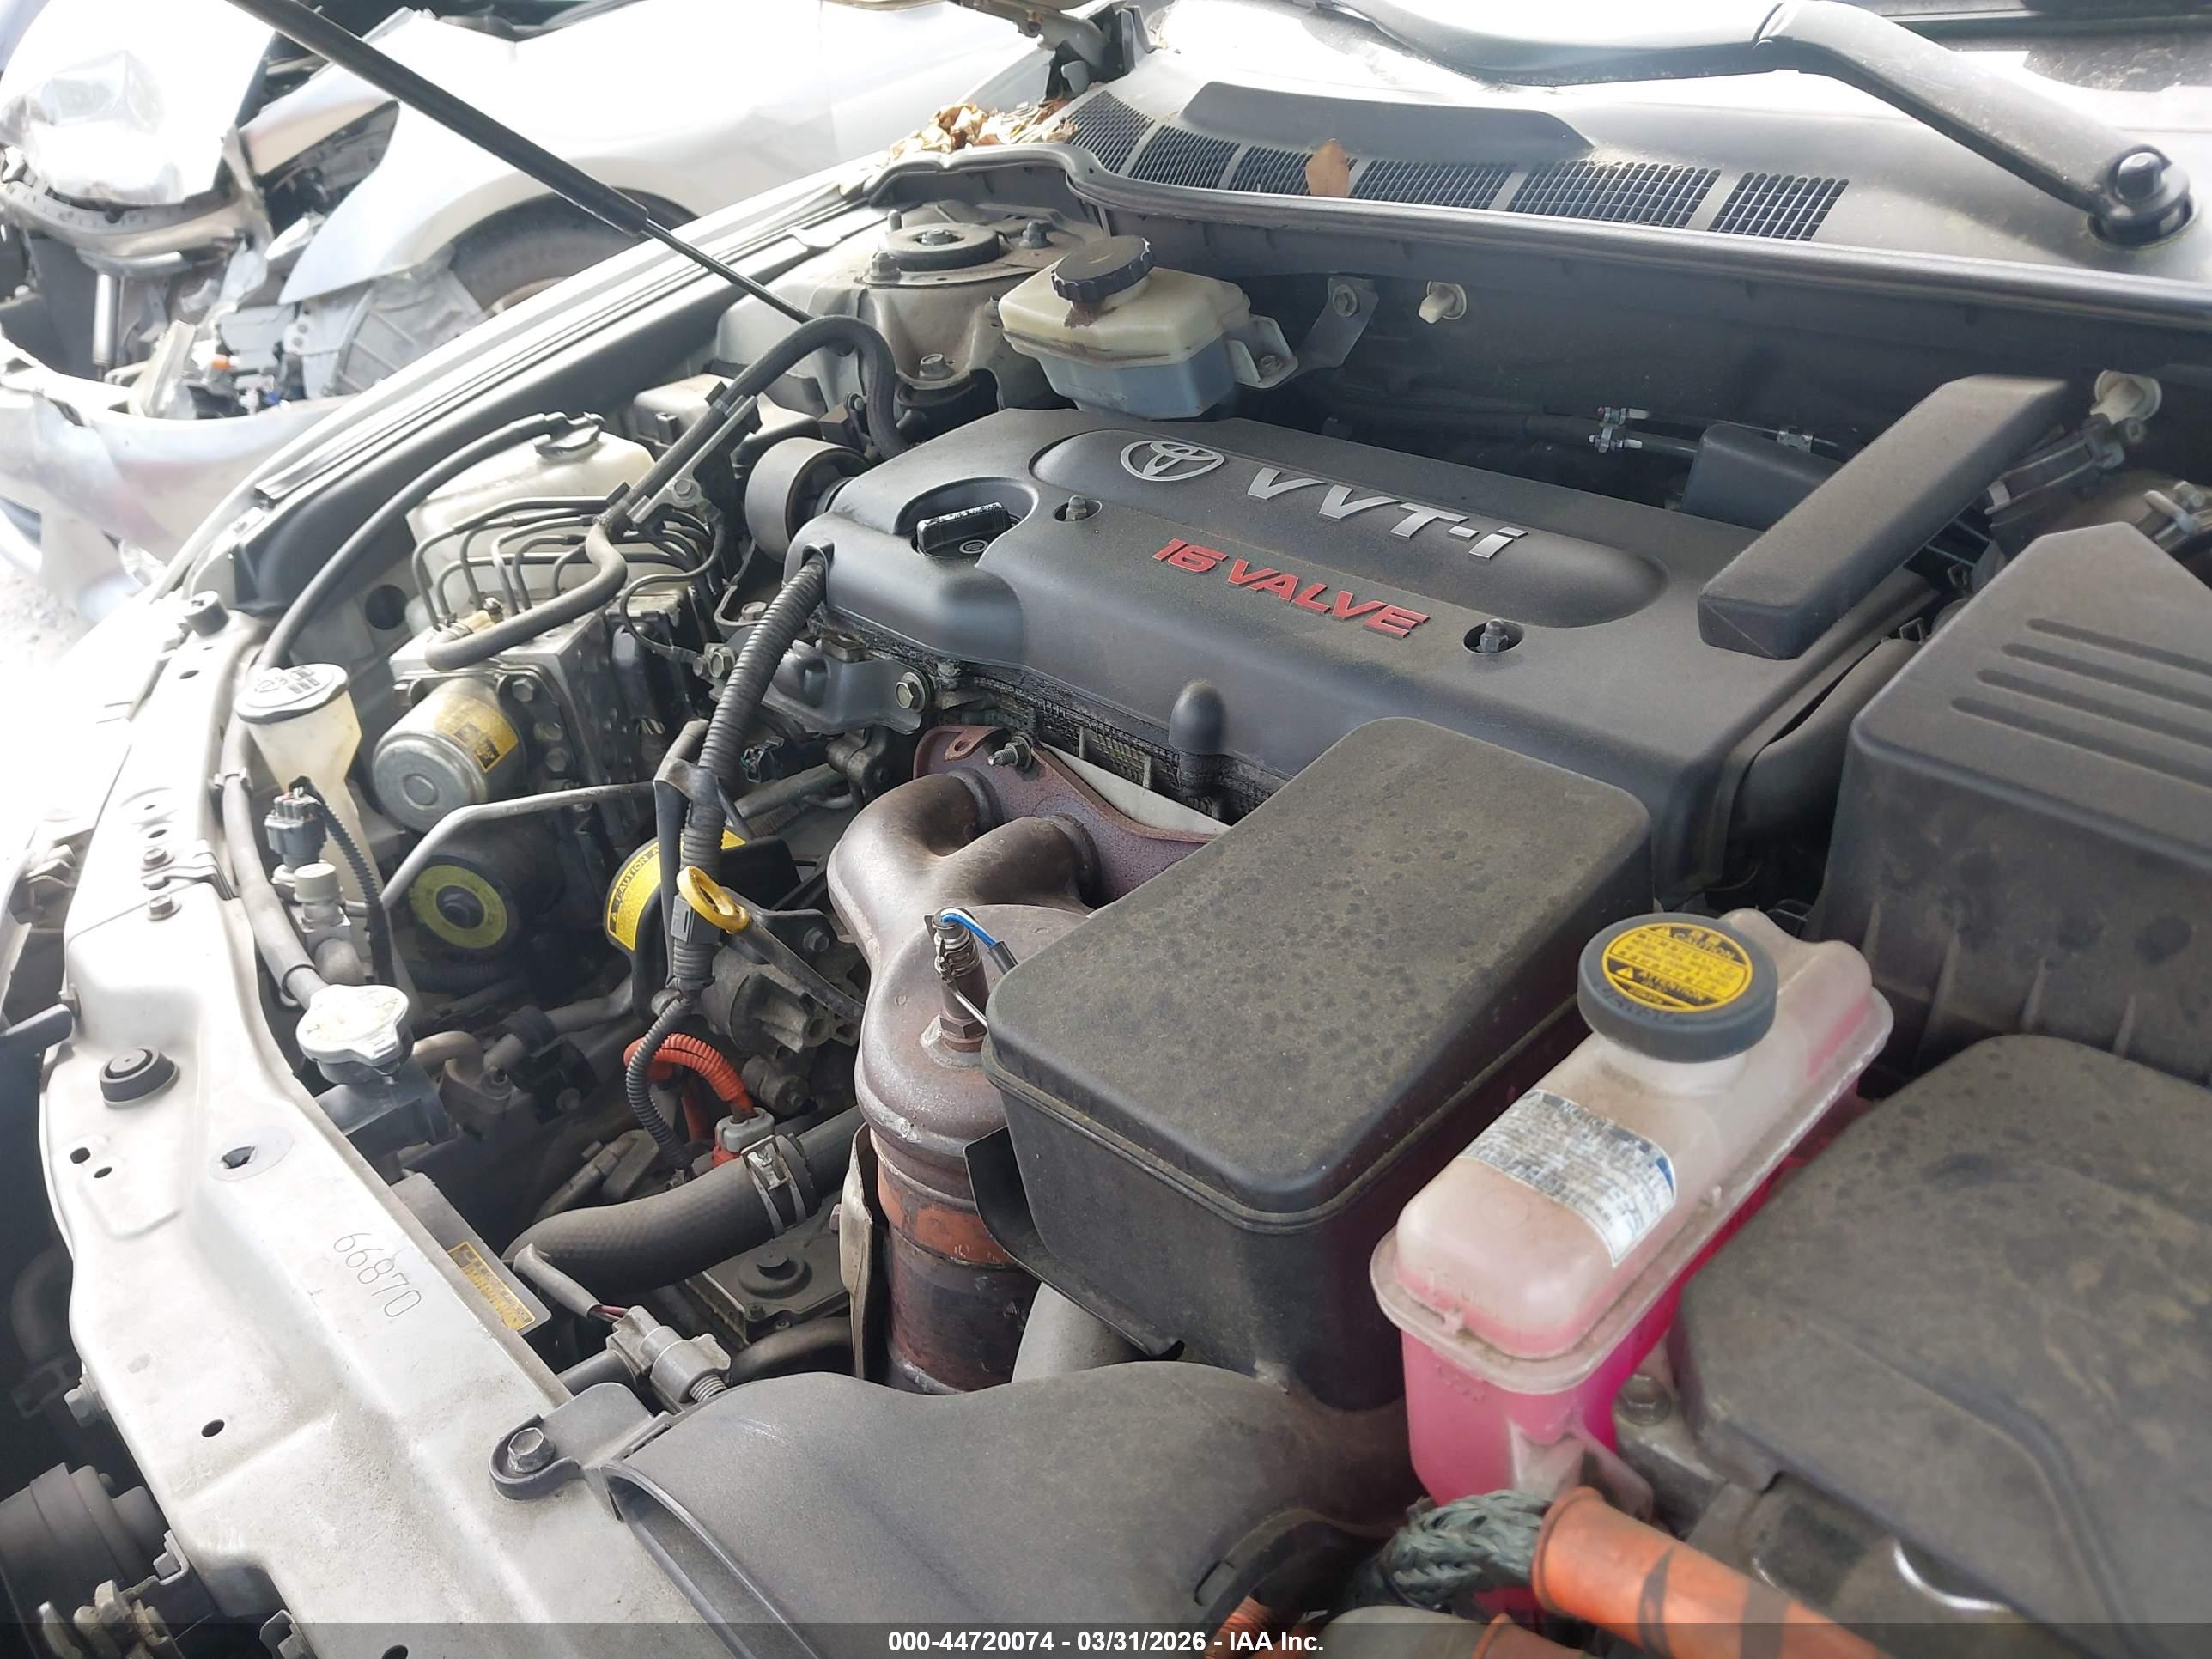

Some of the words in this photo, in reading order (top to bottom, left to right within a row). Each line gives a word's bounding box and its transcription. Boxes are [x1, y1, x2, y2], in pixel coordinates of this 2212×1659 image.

[1247, 467, 1528, 559] VVT-i
[1153, 538, 1230, 573] 16
[1227, 559, 1431, 639] VALVE
[616, 854, 649, 905] CAUTION
[333, 1232, 422, 1317] 66870
